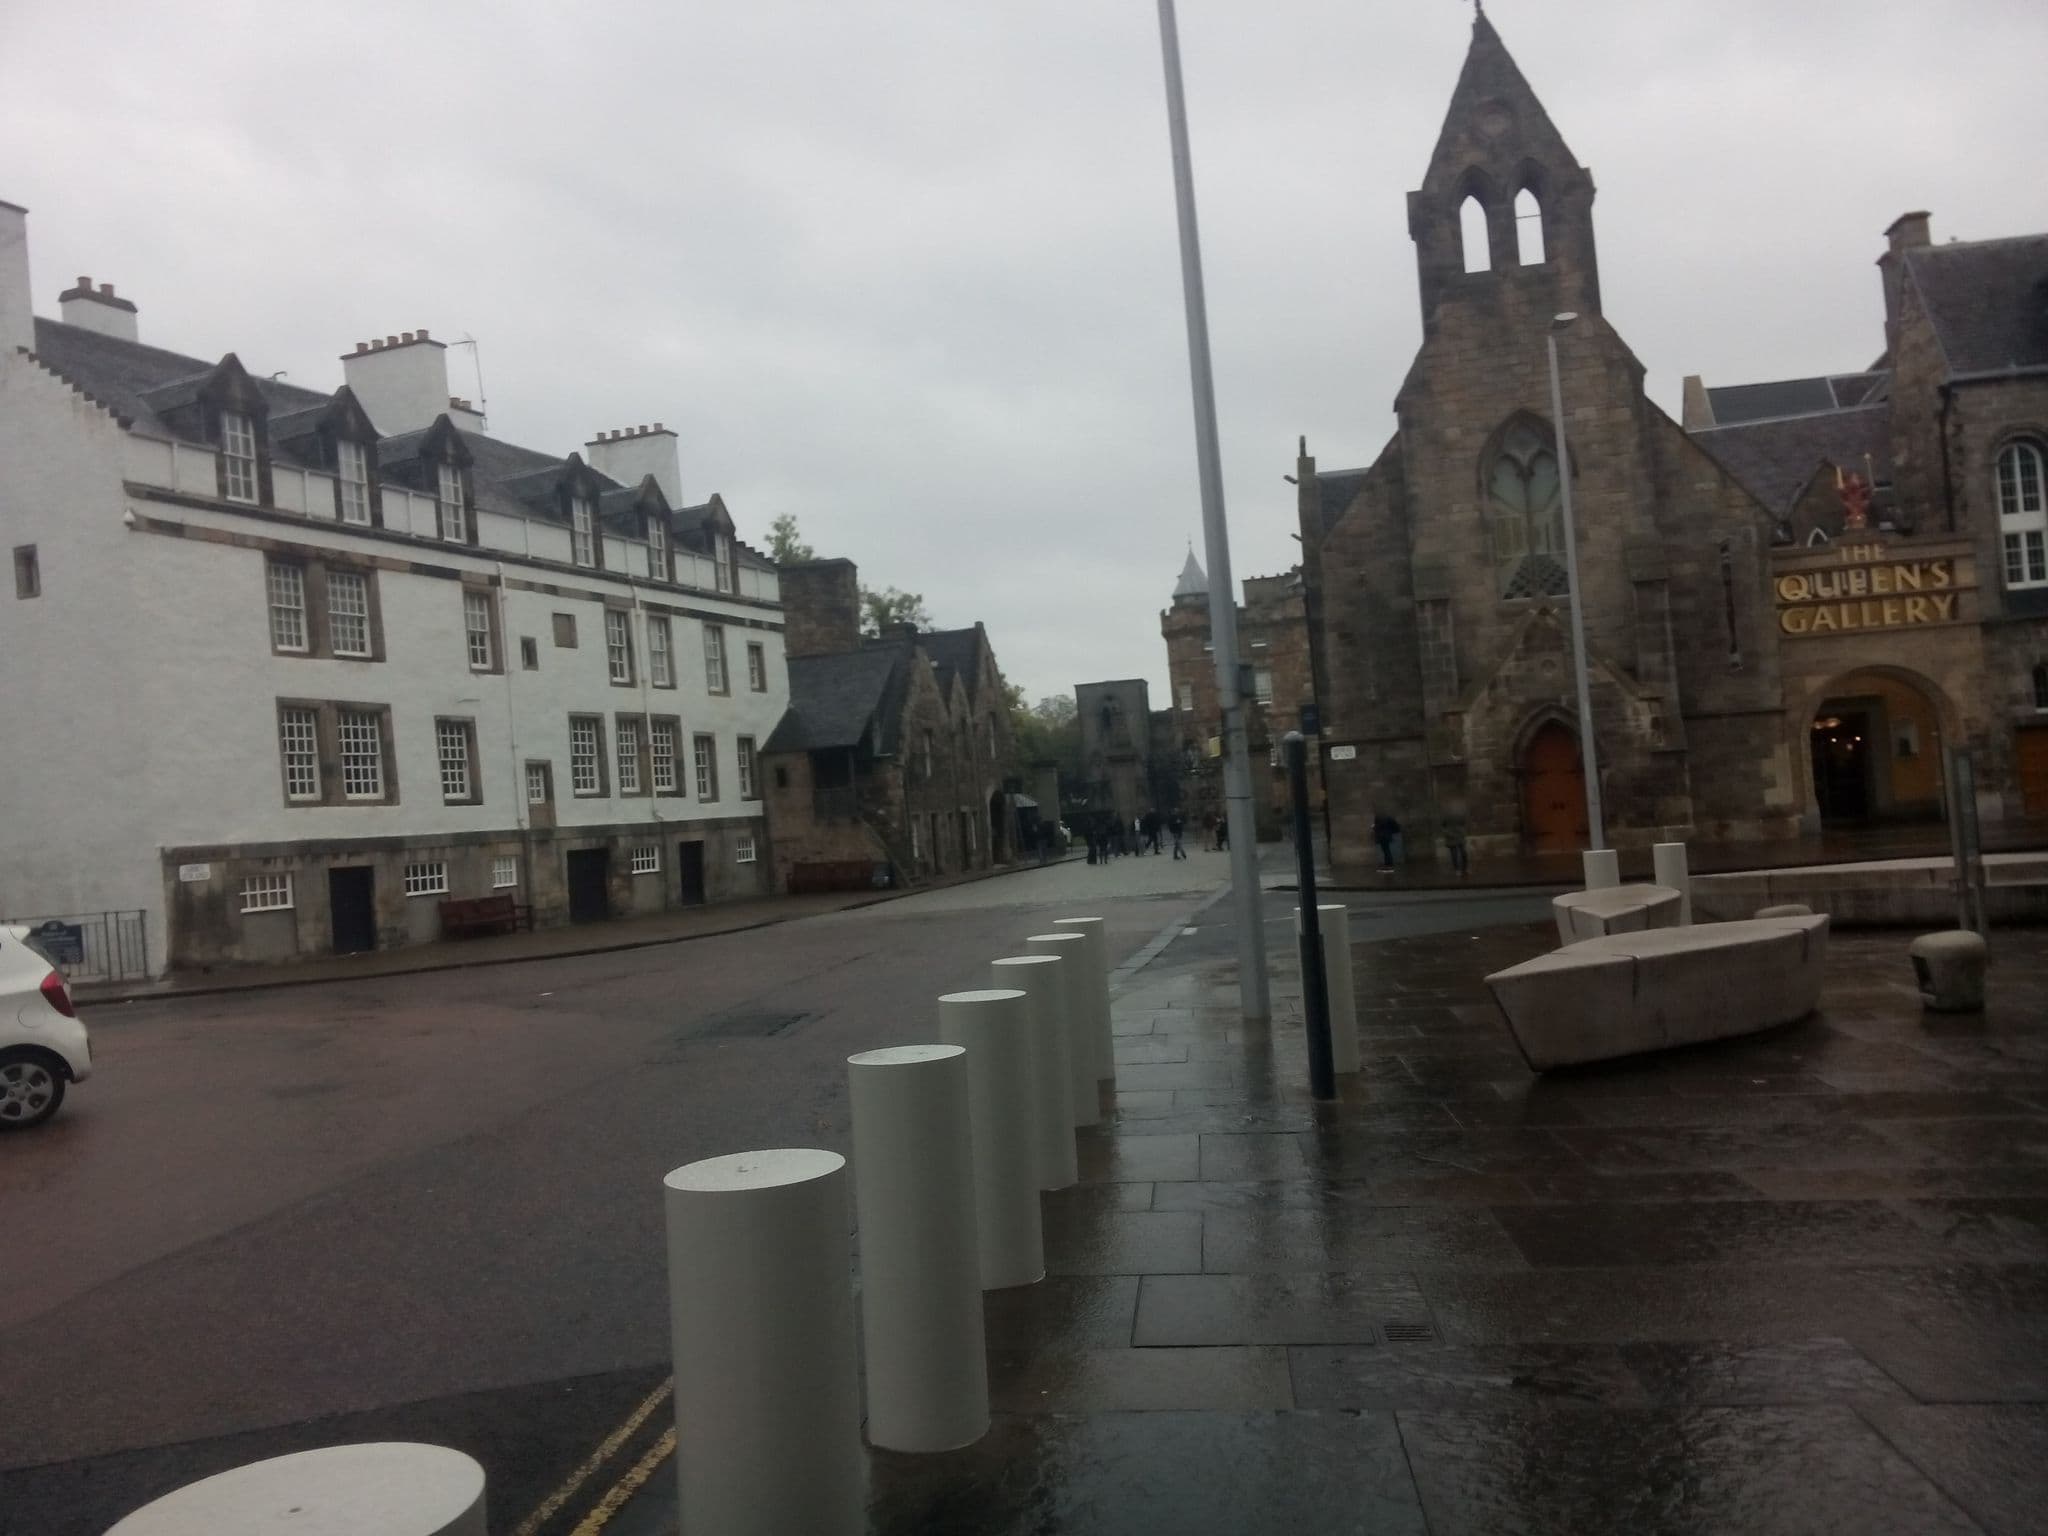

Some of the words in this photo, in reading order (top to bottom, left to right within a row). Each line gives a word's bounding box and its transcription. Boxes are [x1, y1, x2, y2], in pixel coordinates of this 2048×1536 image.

[1839, 543, 1885, 561] THE
[1779, 561, 1950, 601] QUEEN'S
[1781, 594, 1954, 633] GALLERY
